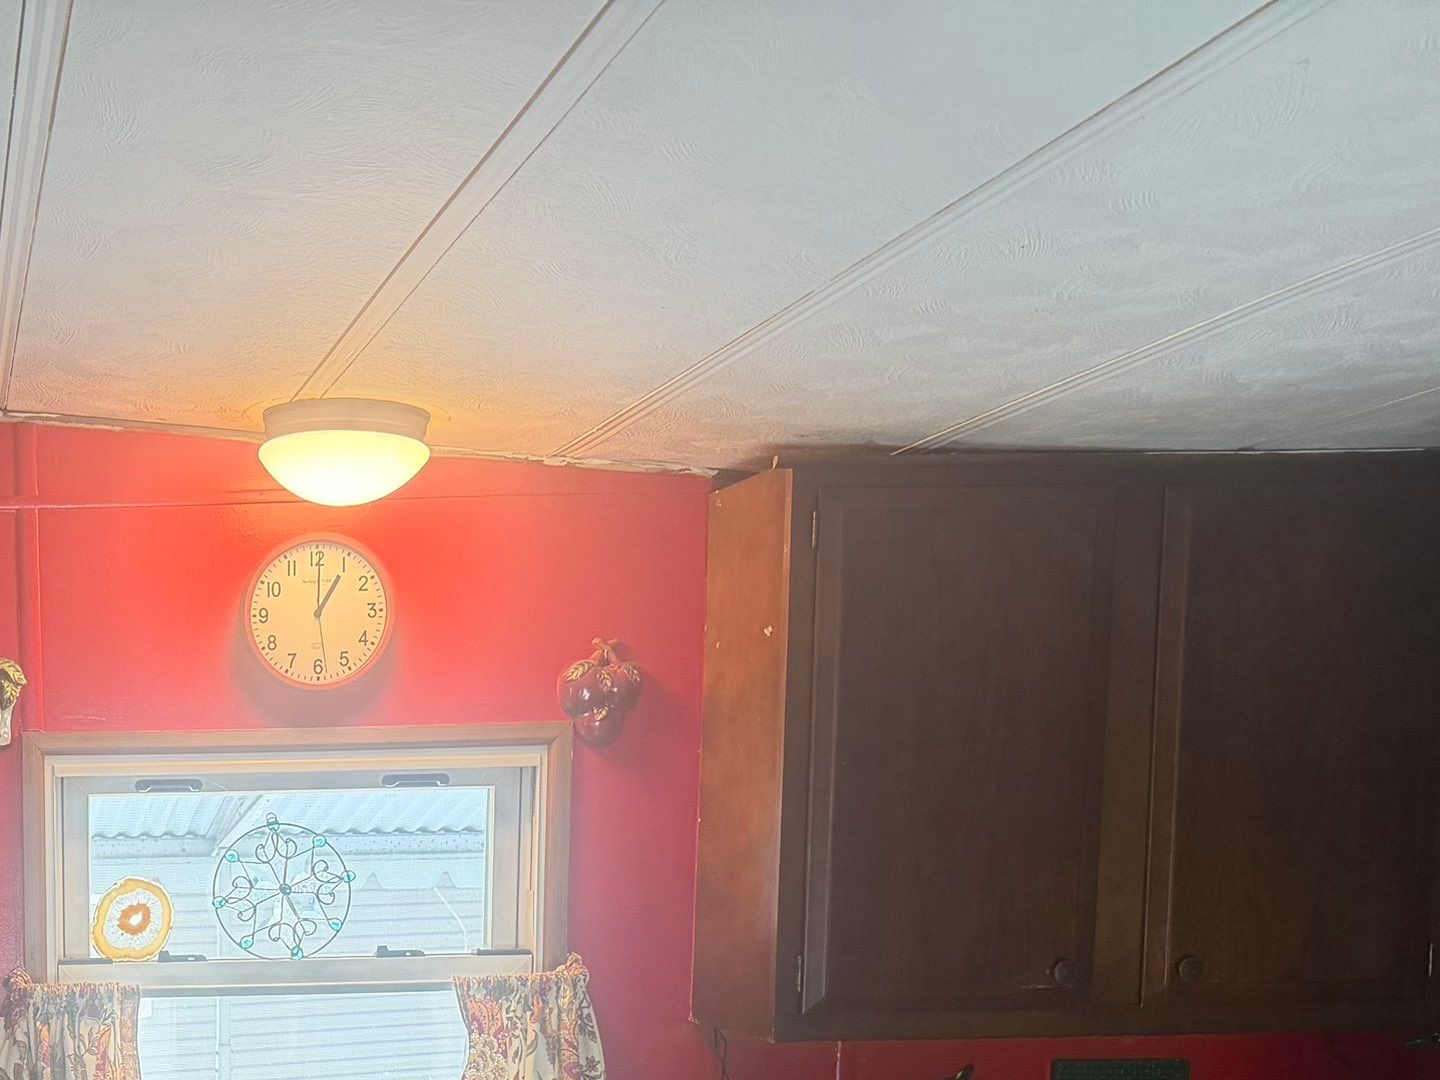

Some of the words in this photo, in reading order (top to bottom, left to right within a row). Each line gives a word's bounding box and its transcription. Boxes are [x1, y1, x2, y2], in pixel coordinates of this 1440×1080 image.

[310, 551, 325, 567] 12
[287, 560, 297, 576] 11
[267, 581, 281, 598] 10
[358, 575, 369, 592] 2
[258, 607, 269, 624] 9
[366, 602, 378, 619] 3
[267, 634, 277, 651] 8
[358, 630, 369, 647] 4
[287, 652, 298, 669] 7
[313, 658, 324, 675] 6
[339, 651, 350, 667] 5
